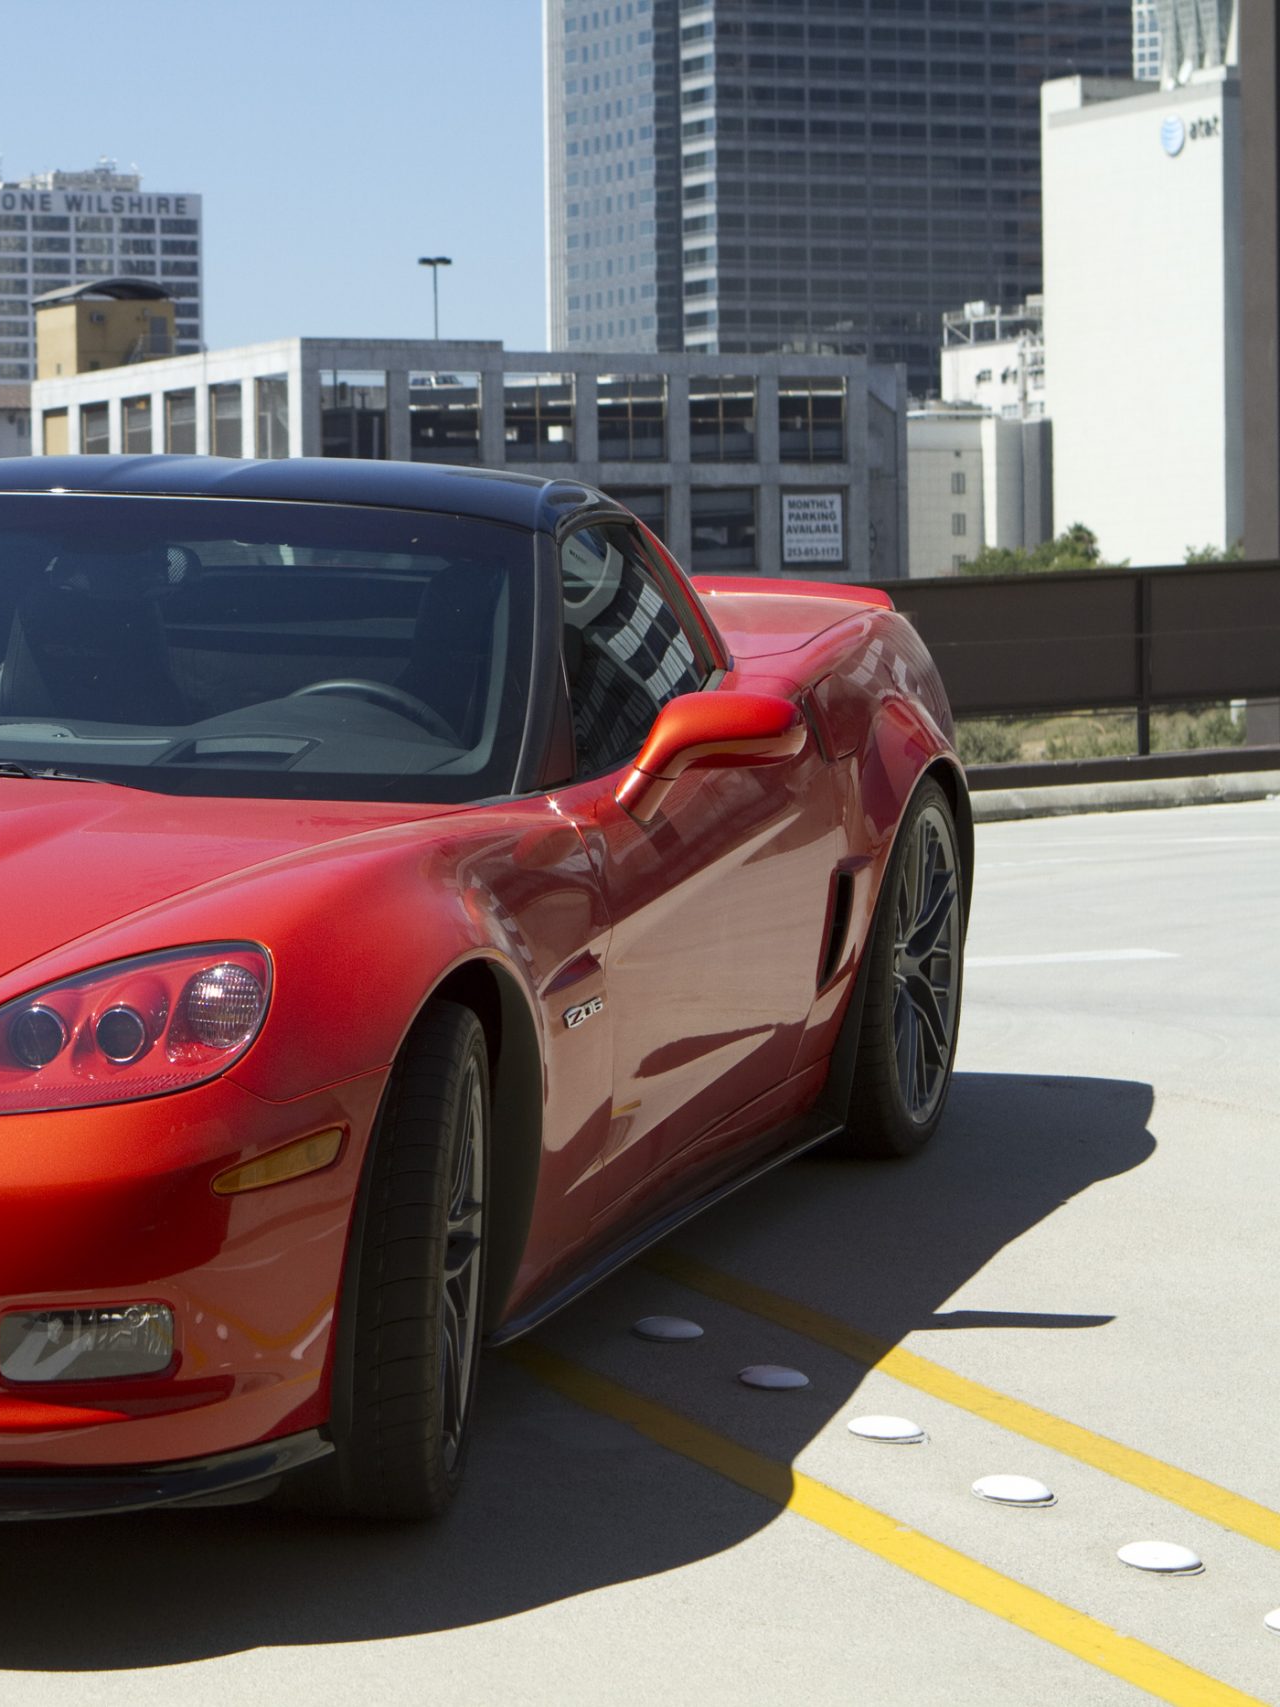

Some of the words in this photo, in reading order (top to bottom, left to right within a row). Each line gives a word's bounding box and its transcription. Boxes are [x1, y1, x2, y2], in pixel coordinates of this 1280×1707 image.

[1, 193, 52, 212] ONE
[65, 194, 187, 215] WILSHIRE
[787, 499, 834, 509] MONTHLY
[788, 511, 837, 521] PARKING
[786, 524, 839, 534] AVAILABLE
[563, 997, 603, 1028] Z06
